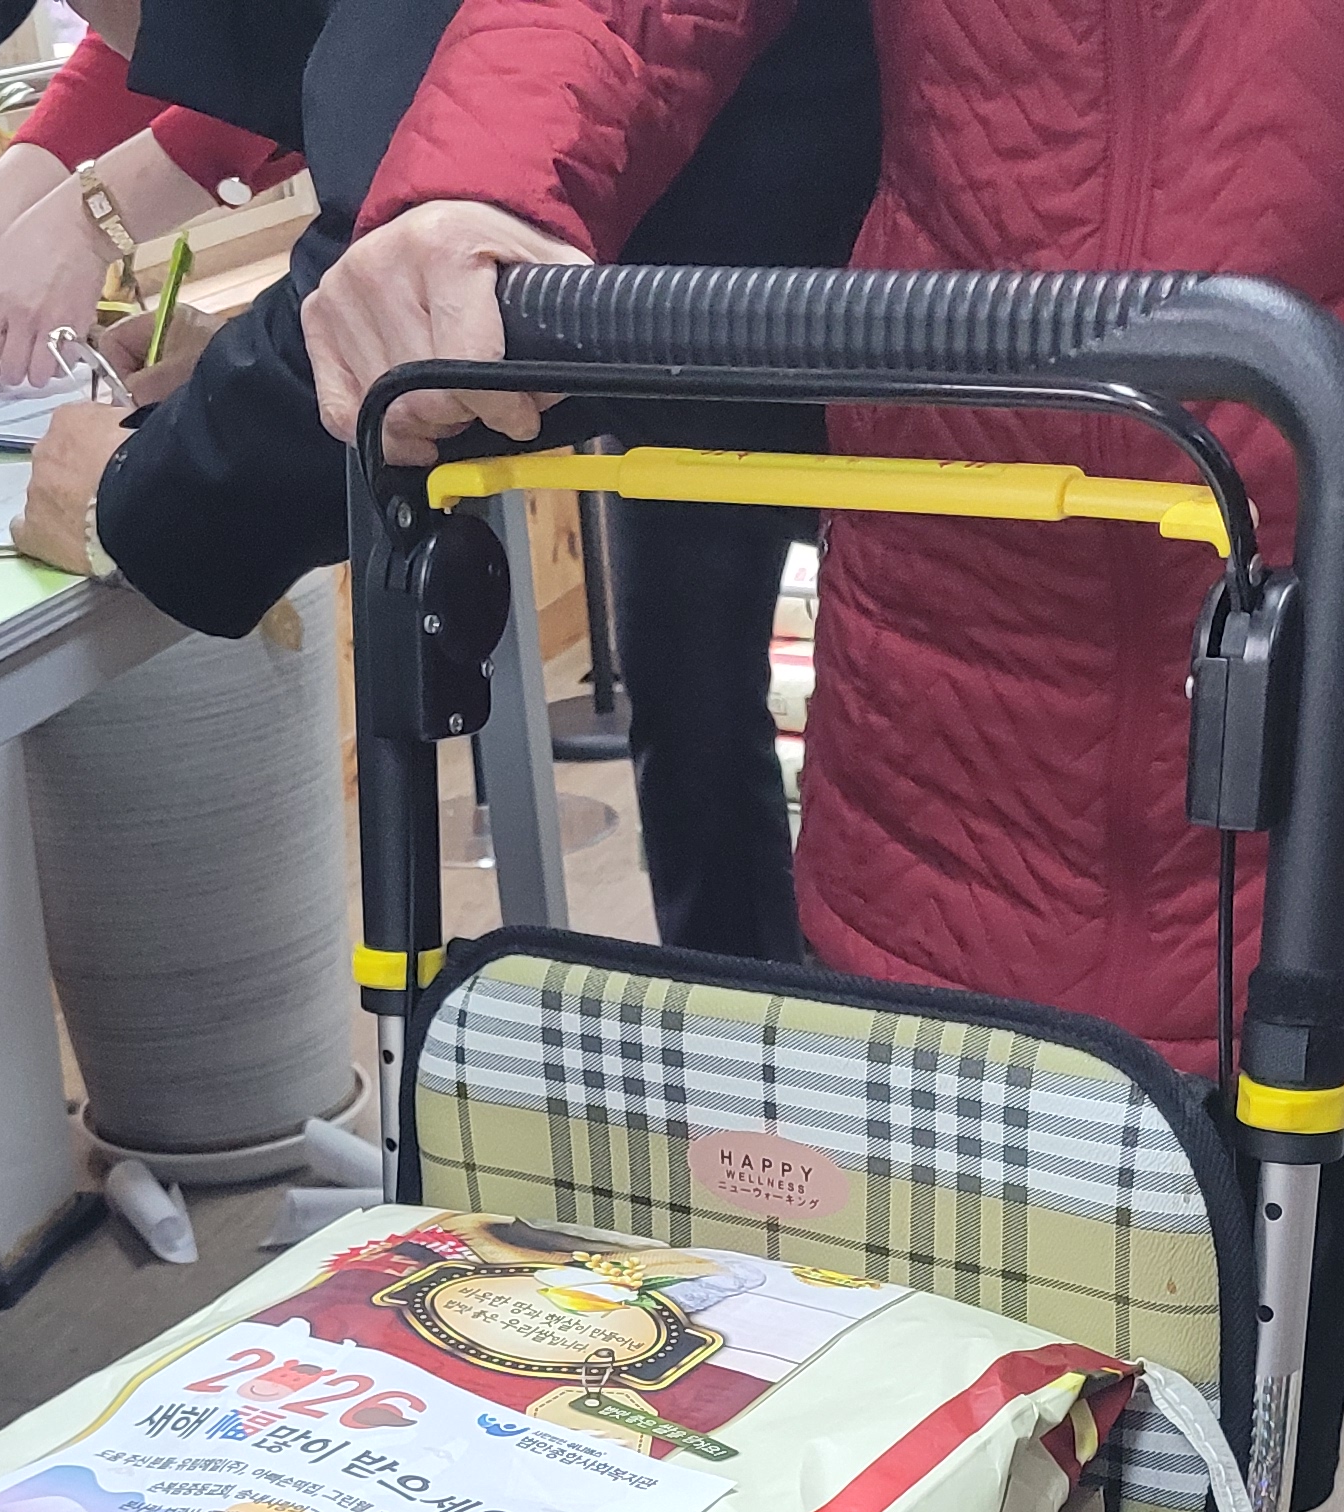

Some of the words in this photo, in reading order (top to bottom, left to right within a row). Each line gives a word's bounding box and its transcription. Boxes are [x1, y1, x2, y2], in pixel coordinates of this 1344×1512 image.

[720, 1149, 813, 1182] HAPPY
[726, 1169, 805, 1194] WELLNESS
[718, 1181, 819, 1210] ニューウォーキング
[443, 1299, 472, 1315] 밥맛
[472, 1310, 500, 1323] 좋은
[500, 1318, 588, 1354] 우리쌀입니다.
[459, 1286, 512, 1308] 비옥한
[545, 1312, 591, 1333] 햇살이
[588, 1328, 645, 1352] 만들어낸
[135, 1402, 218, 1440] 새해
[252, 1423, 349, 1466] 많이
[94, 1449, 127, 1463] 도움
[123, 1453, 153, 1468] 주신
[515, 1436, 659, 1490] 범안종합사회복지관
